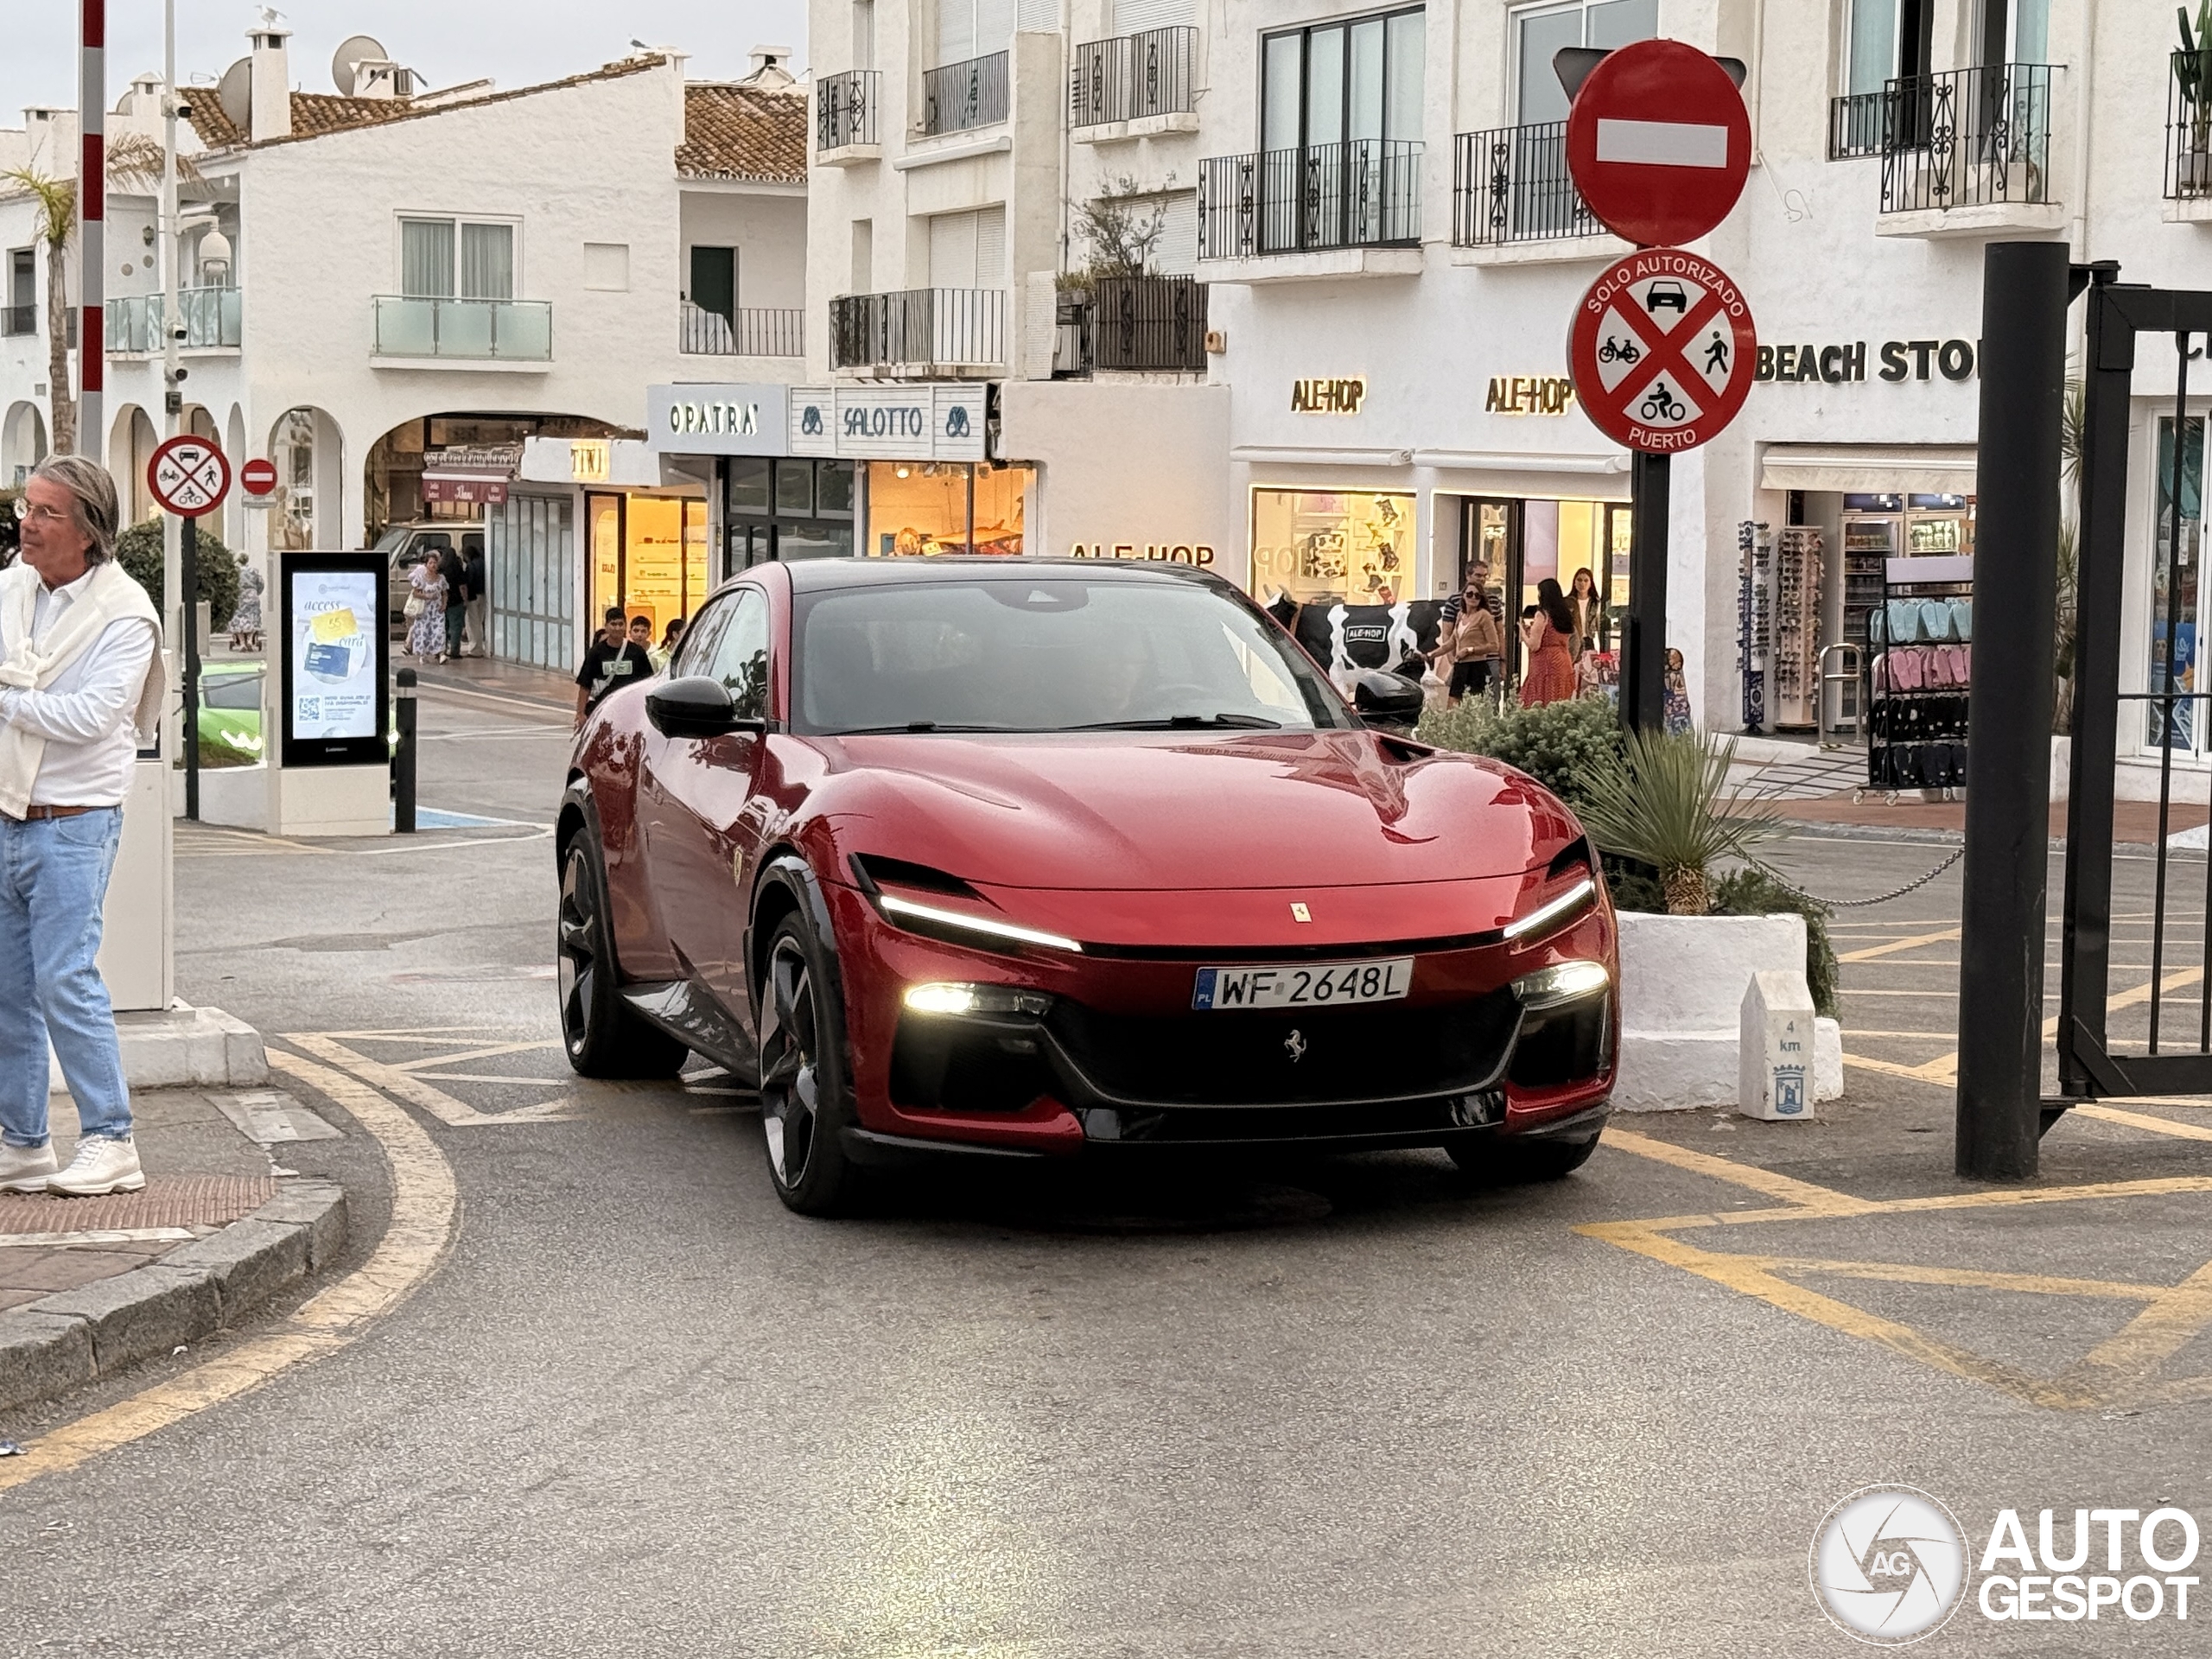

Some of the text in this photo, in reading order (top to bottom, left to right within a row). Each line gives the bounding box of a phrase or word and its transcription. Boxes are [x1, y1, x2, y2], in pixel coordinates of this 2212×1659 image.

[1588, 257, 1744, 317] SOLO AUTORIZADO
[1754, 339, 1982, 383] BEACH STO
[1291, 378, 1365, 414] ALE-HOP
[1485, 378, 1576, 415] ALE-HOP
[843, 407, 923, 437] SALOTTO
[1629, 426, 1696, 449] PUERTO
[303, 600, 342, 612] access
[339, 632, 365, 647] card
[1348, 628, 1382, 639] ALE-HOP
[1222, 965, 1402, 1004] WF 2648L
[1786, 1020, 1795, 1033] 4
[1779, 1039, 1801, 1052] km
